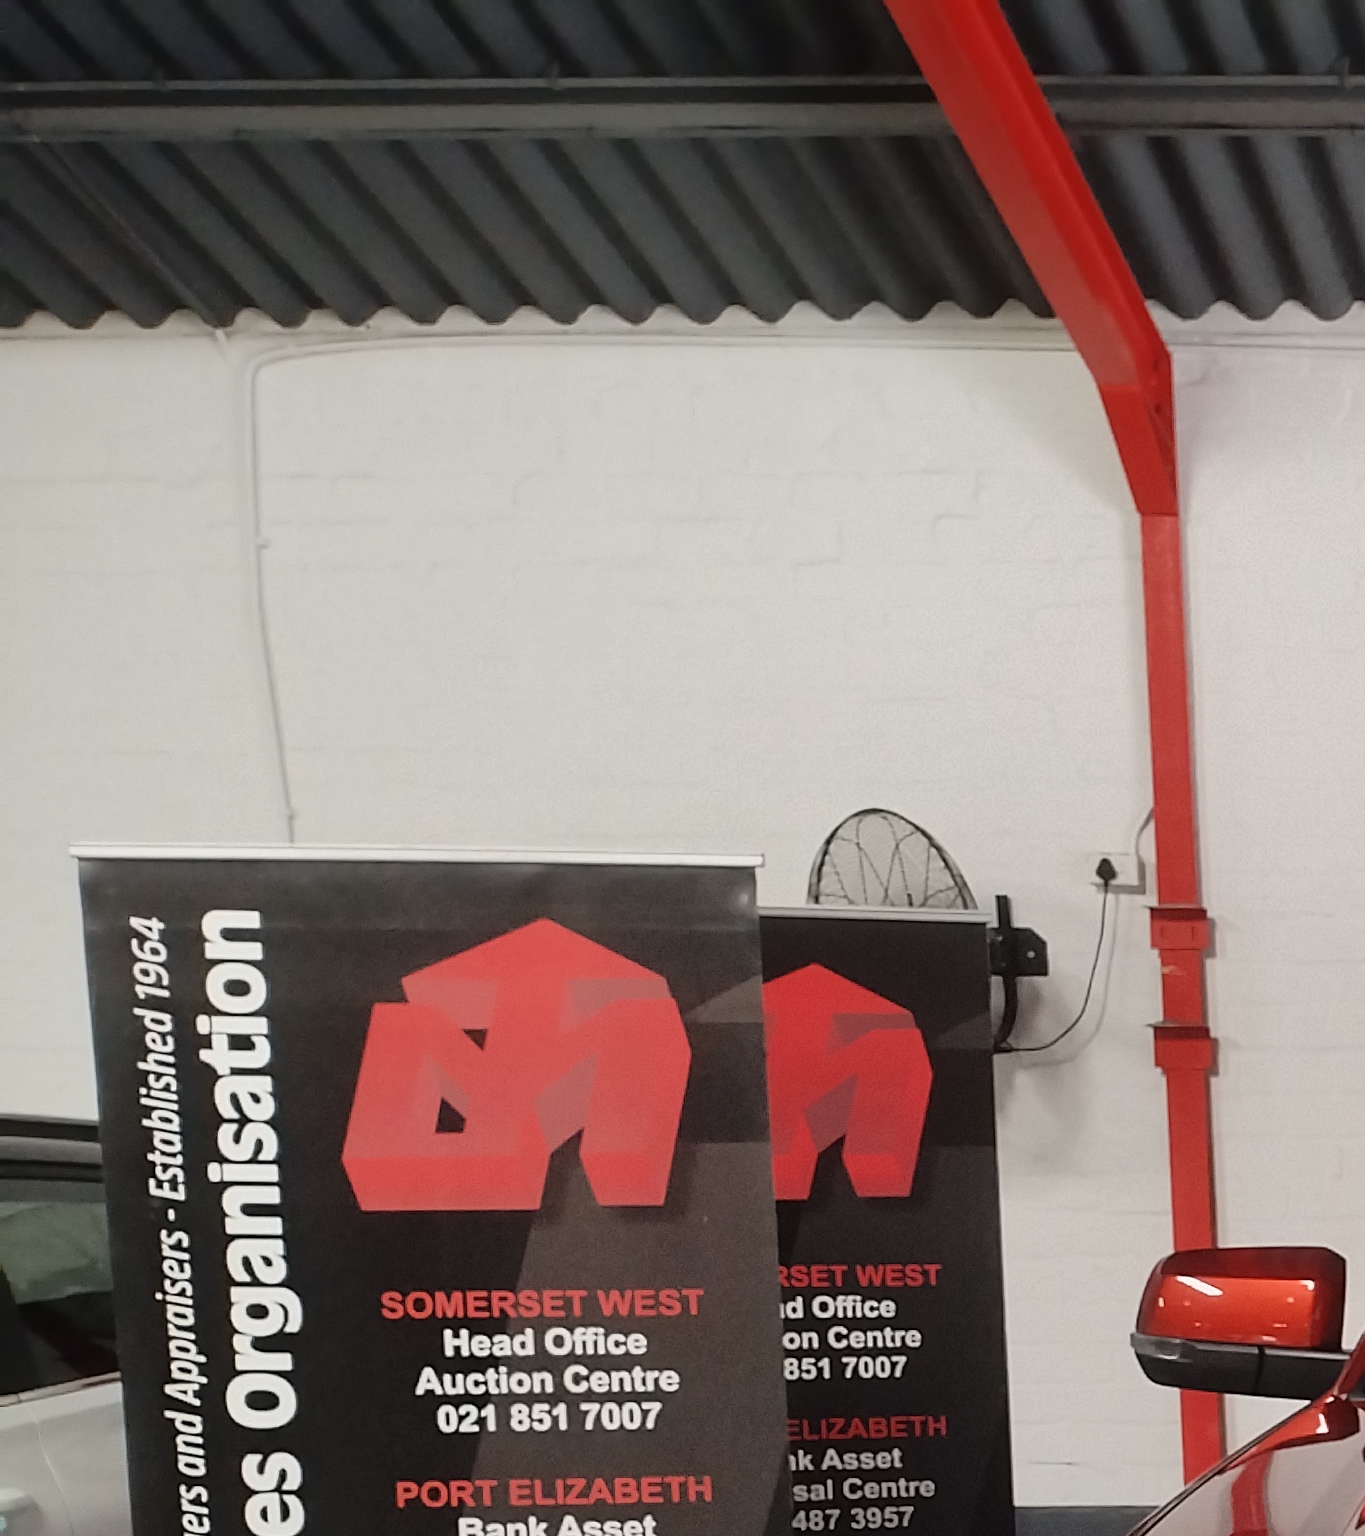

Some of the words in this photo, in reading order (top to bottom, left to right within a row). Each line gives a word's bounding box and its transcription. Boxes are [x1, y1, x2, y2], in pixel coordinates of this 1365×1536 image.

[129, 915, 170, 999] 1964
[133, 1007, 186, 1201] Established
[195, 909, 302, 1430] Organisation
[855, 1263, 942, 1288] WEST
[155, 1228, 208, 1406] Appraisers
[380, 1289, 589, 1320] SOMERSET
[596, 1288, 705, 1317] WEST
[811, 1295, 897, 1319] Office
[442, 1327, 536, 1358] Head
[544, 1326, 648, 1356] Office
[826, 1325, 922, 1349] Centre
[415, 1365, 555, 1396] Auction
[563, 1364, 681, 1394] Centre
[783, 1357, 831, 1380] 851
[841, 1355, 907, 1379] 7007
[437, 1403, 497, 1434] 021
[509, 1402, 568, 1432] 851
[579, 1401, 663, 1431] 7007
[787, 1415, 948, 1441] ELIZABETH
[164, 1409, 206, 1477] and
[821, 1447, 904, 1471] Asset
[396, 1479, 499, 1508] PORT
[508, 1475, 713, 1507] ELIZABETH
[842, 1477, 936, 1500] Centre
[791, 1508, 841, 1531] 487
[850, 1505, 915, 1530] 3957
